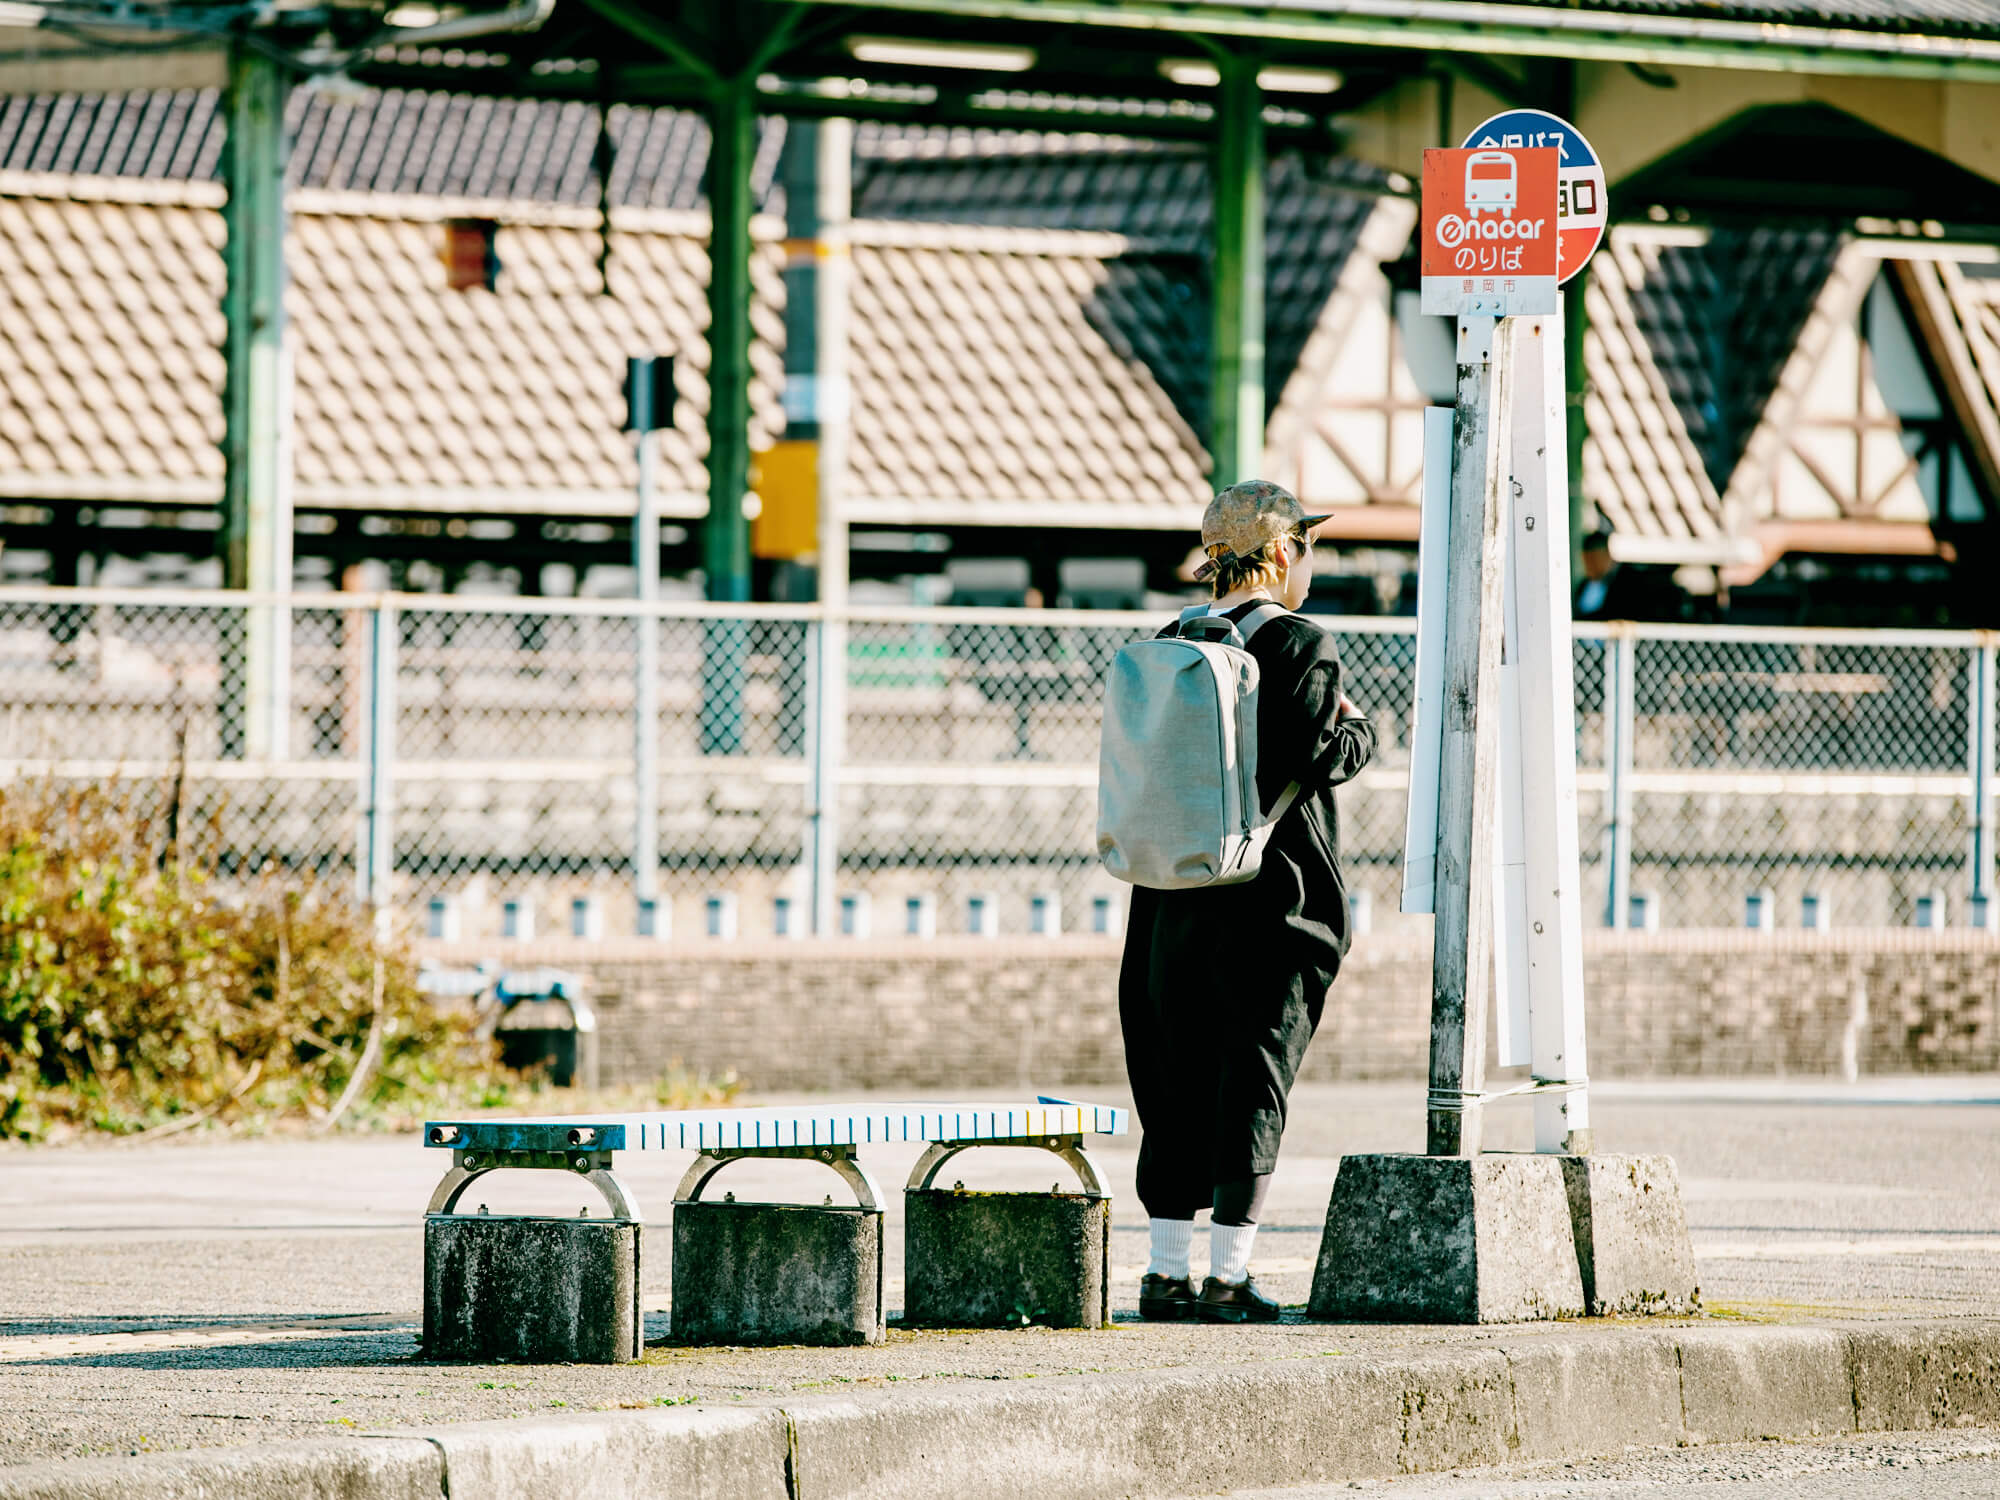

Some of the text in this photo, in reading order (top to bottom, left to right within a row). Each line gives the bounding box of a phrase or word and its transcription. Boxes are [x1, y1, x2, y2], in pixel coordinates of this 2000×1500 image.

[1455, 244, 1524, 271] のりば
[1463, 279, 1516, 294] 豊岡市
